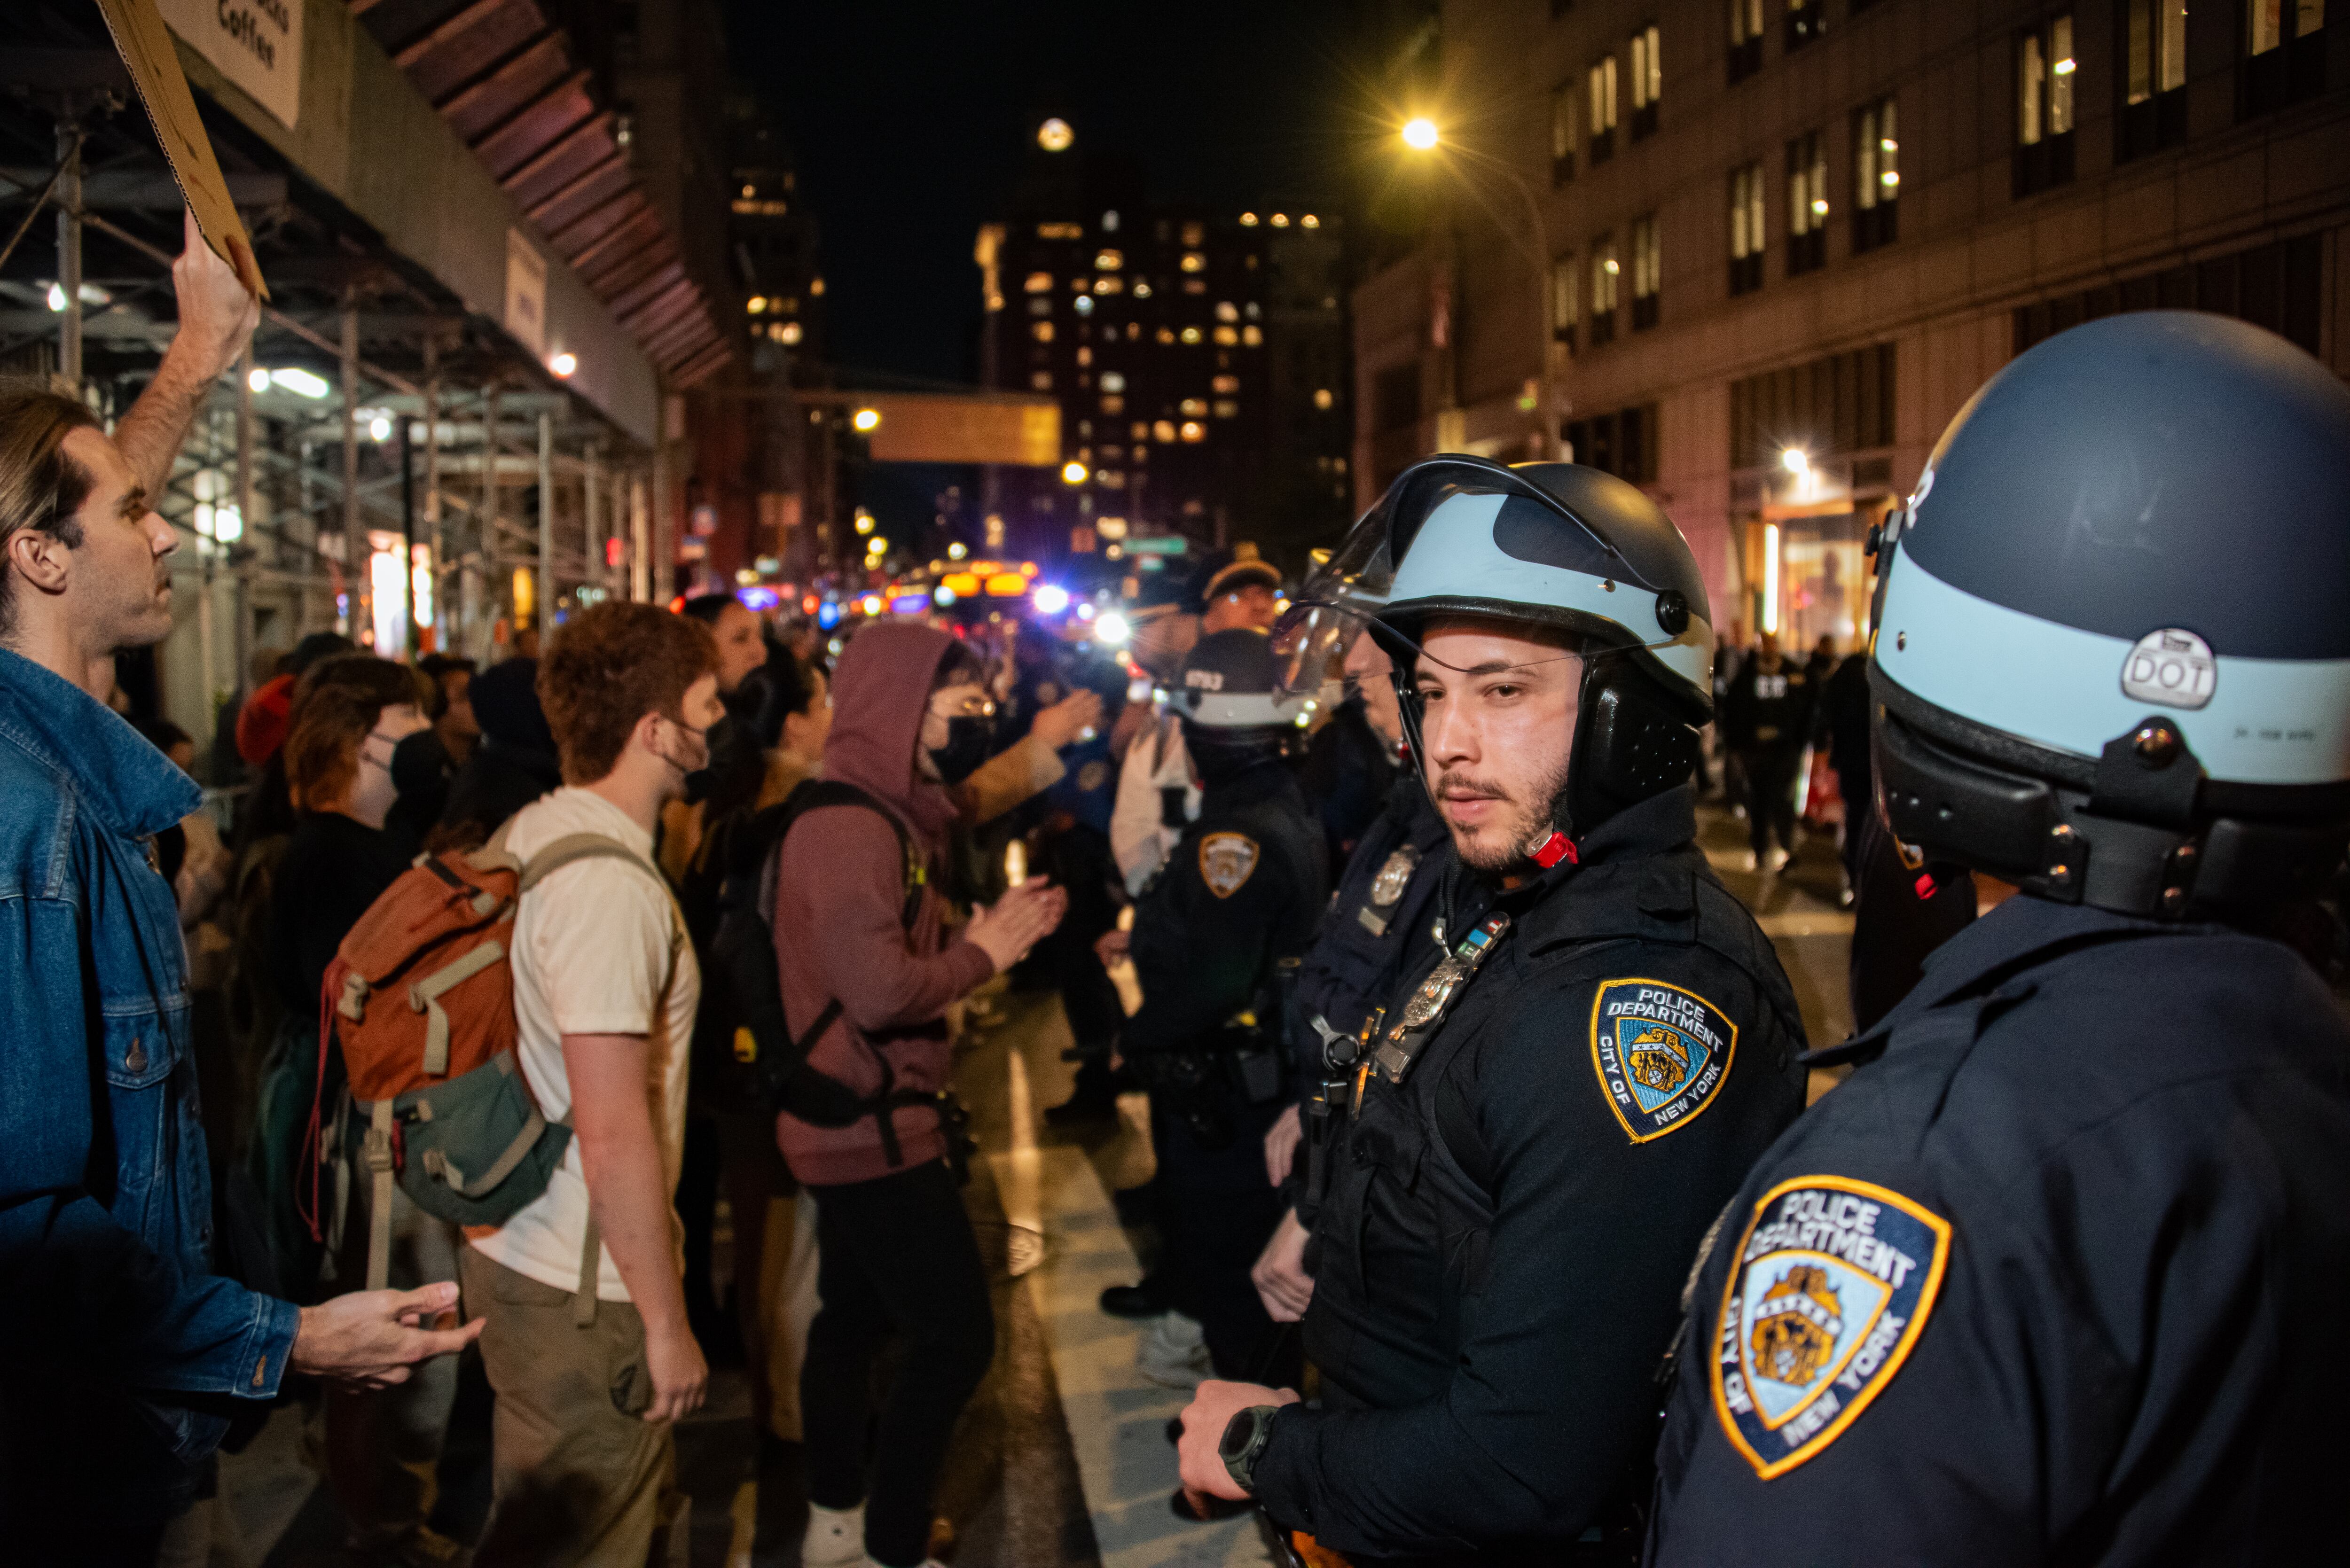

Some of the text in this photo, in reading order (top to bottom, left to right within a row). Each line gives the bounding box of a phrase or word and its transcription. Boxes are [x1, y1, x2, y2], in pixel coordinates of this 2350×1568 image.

[218, 0, 274, 70] Coffee
[2131, 653, 2211, 694] DOT
[1608, 1002, 1723, 1053] DEPARTMENT
[1639, 989, 1705, 1023] POLICE
[1600, 1036, 1630, 1104] CITY OF
[1654, 1062, 1721, 1126] NEW YORK
[1779, 1190, 1880, 1235] POLICE
[1781, 1310, 1905, 1447] NEW YORK
